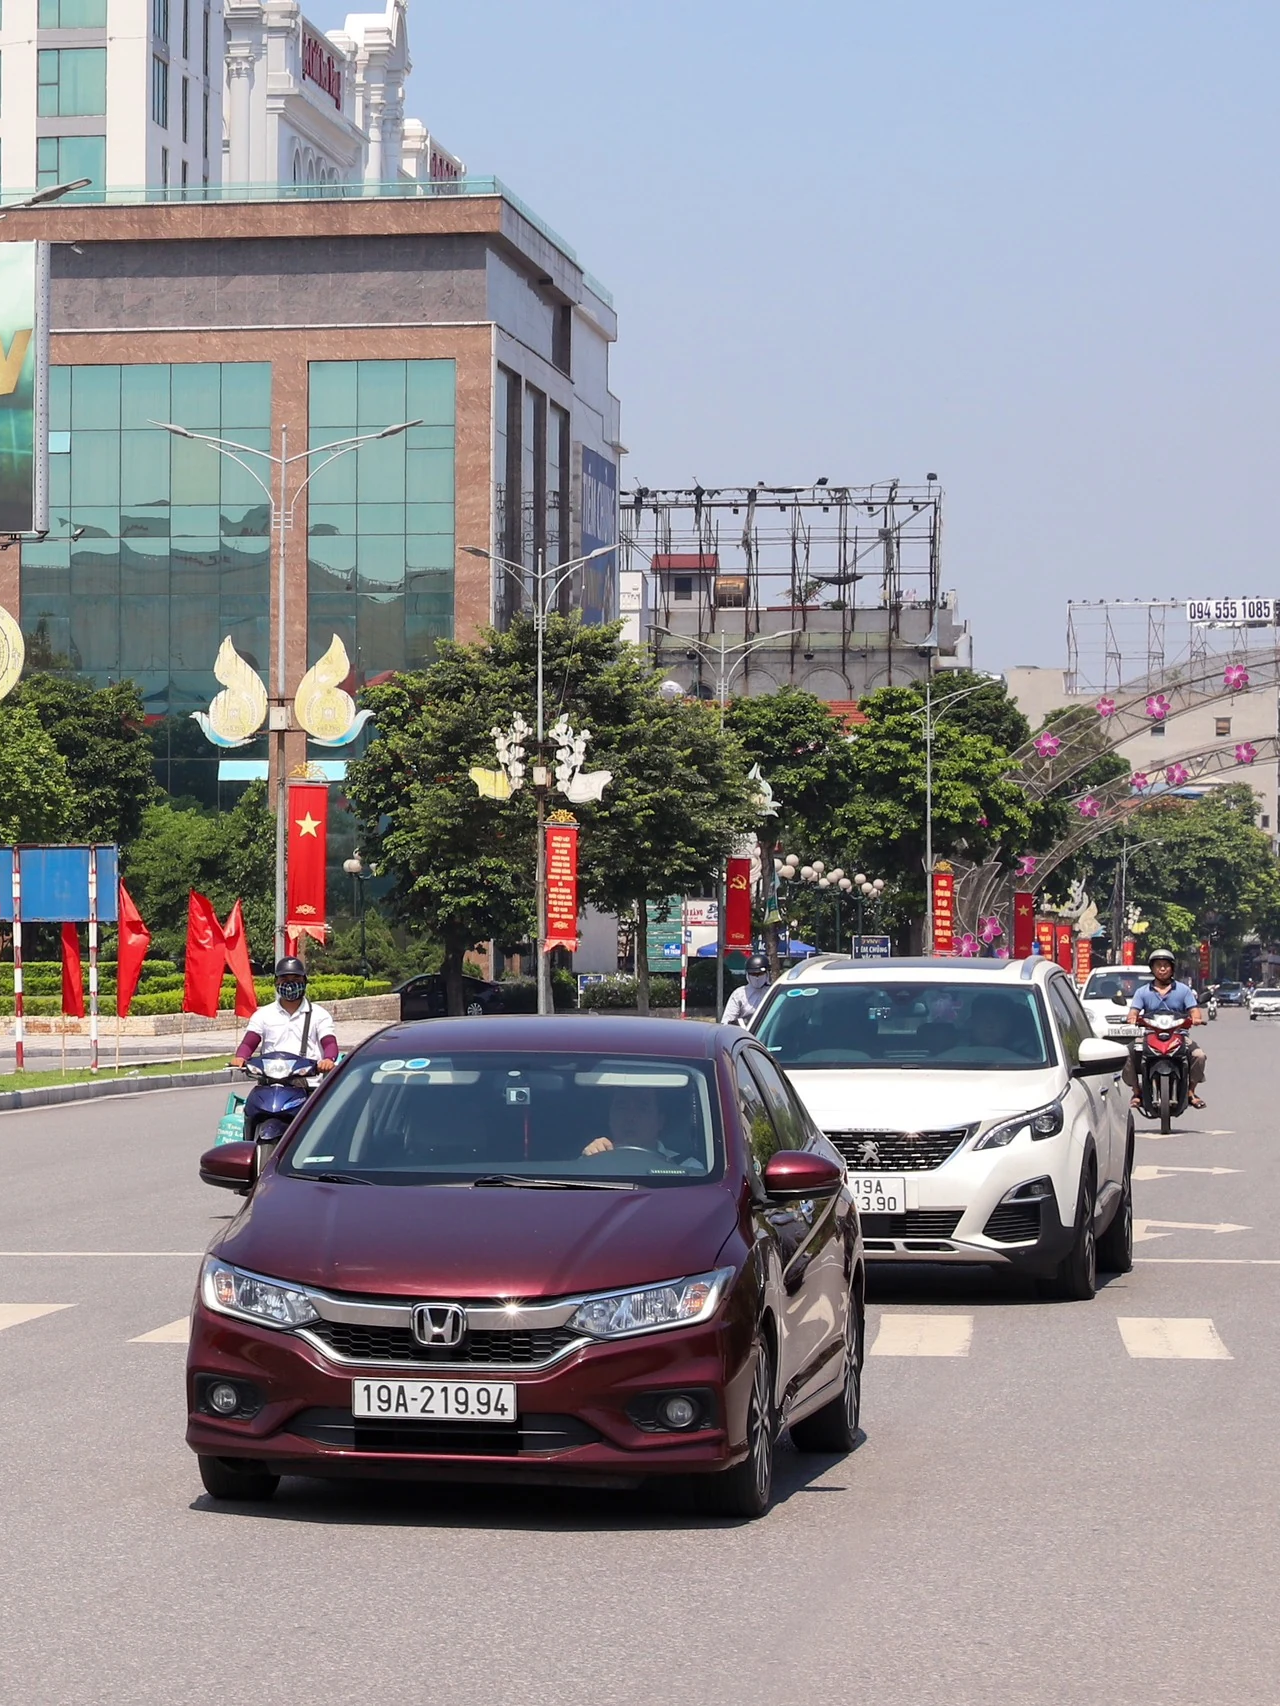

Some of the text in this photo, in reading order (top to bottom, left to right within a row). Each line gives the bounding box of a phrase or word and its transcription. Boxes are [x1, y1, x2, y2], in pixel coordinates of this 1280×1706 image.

[1189, 600, 1271, 619] 094 555 1085
[854, 1179, 884, 1195] 19A
[855, 1196, 897, 1212] 3.90
[363, 1384, 509, 1416] 19A-219.94
